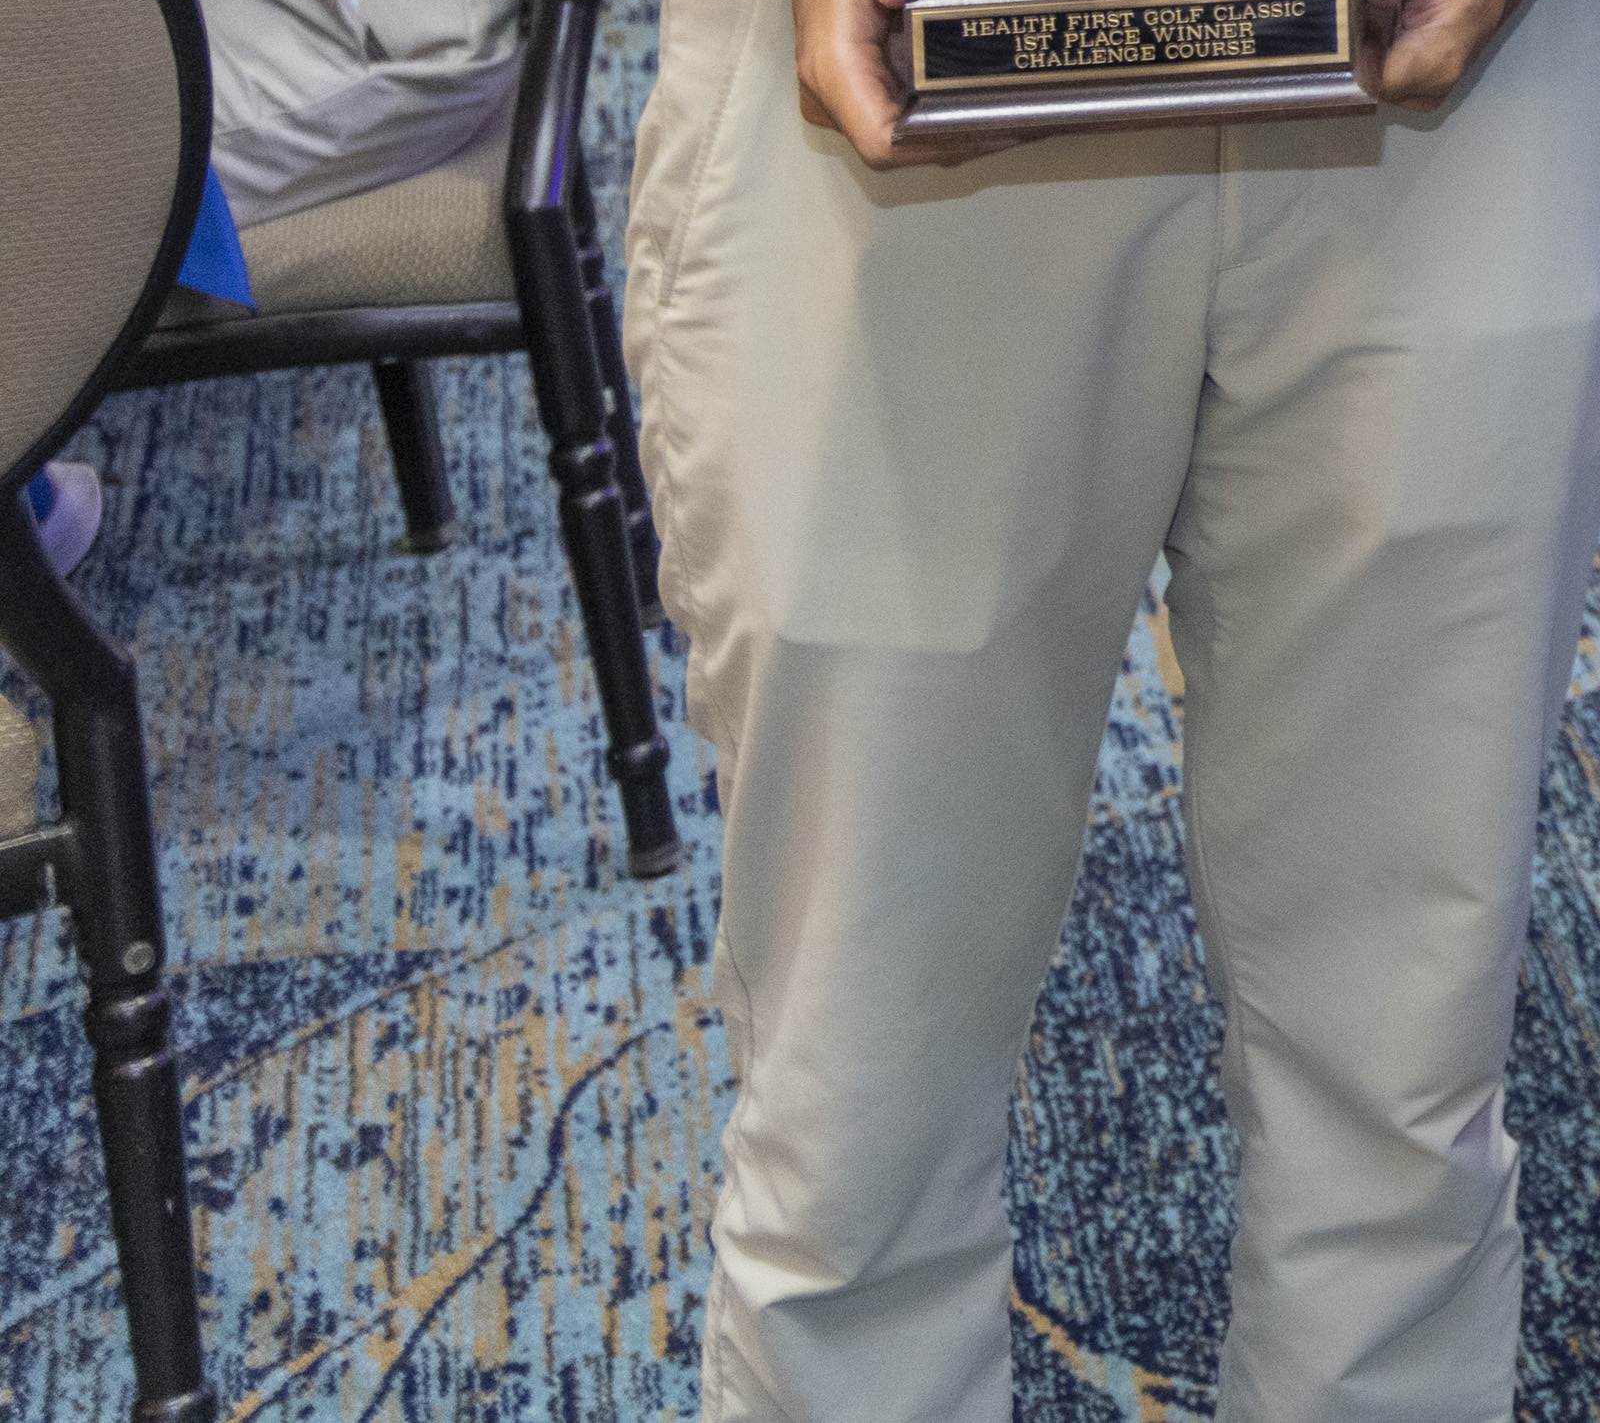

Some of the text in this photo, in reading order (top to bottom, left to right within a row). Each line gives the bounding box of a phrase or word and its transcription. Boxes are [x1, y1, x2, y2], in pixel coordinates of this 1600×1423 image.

[962, 1, 1306, 38] HEALTH FIRST GOLF CLASSIC
[1015, 21, 1255, 52] 1ST PLACE WINNER
[1014, 38, 1256, 70] CHALLENGE COURSE
